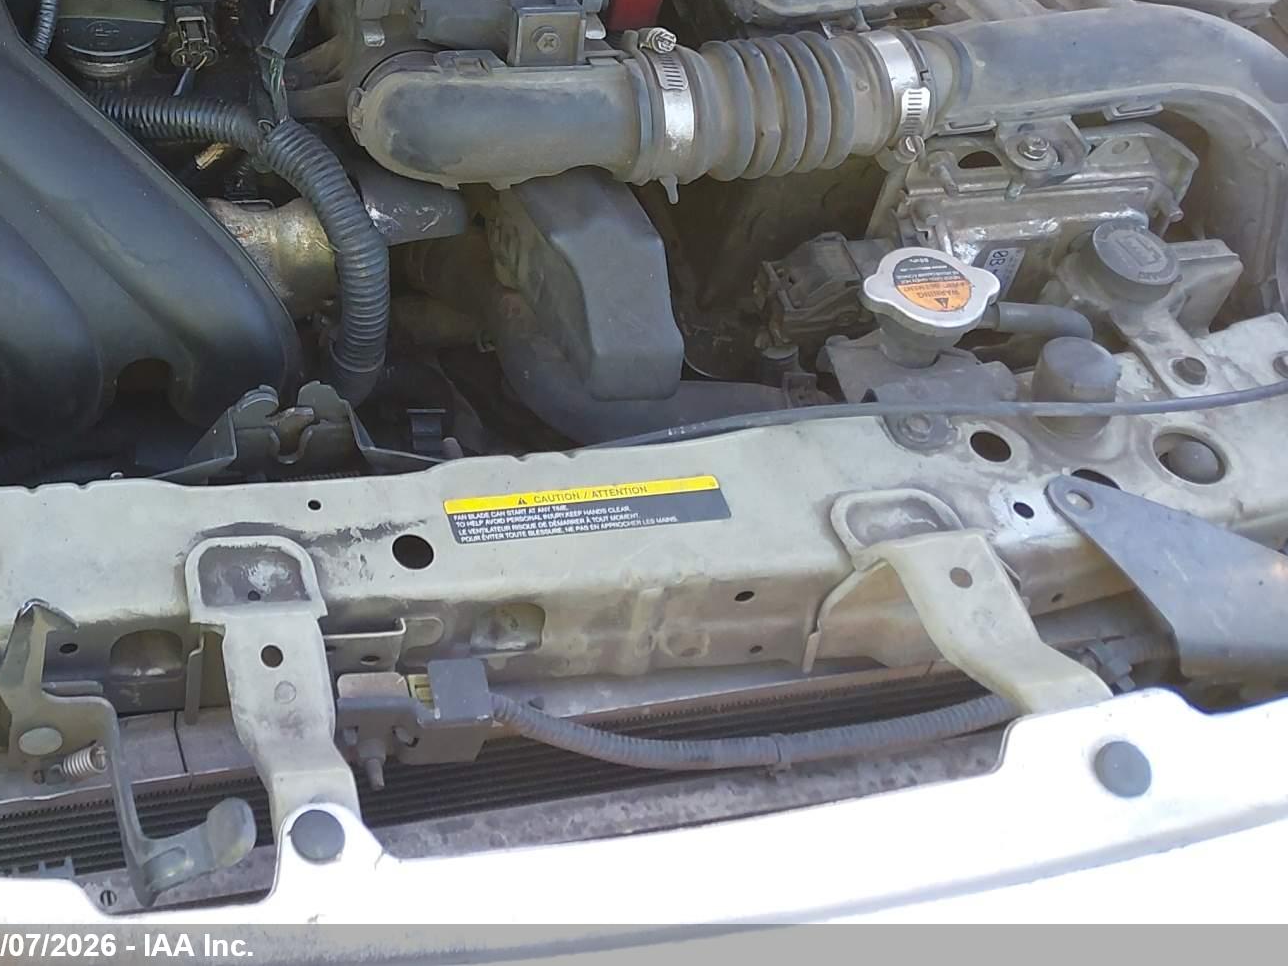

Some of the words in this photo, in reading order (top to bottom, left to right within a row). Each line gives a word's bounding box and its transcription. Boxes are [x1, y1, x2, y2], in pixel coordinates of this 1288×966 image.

[533, 491, 579, 503] CAUTION
[592, 485, 647, 498] ATTENTION
[466, 519, 482, 527] HELP
[485, 517, 504, 525] AVOID
[506, 513, 542, 523] PERSONAL
[583, 507, 606, 516] HANDS
[468, 512, 489, 520] BLADE
[506, 508, 526, 516] START
[459, 528, 467, 536] LE
[468, 524, 510, 535] VENTILATEUR
[512, 522, 536, 531] RISQUE
[591, 515, 609, 523] TOUT
[461, 534, 480, 543] POUR
[506, 530, 526, 538] TOUTE
[600, 519, 641, 529] APPROCHER
[642, 518, 654, 526] LES
